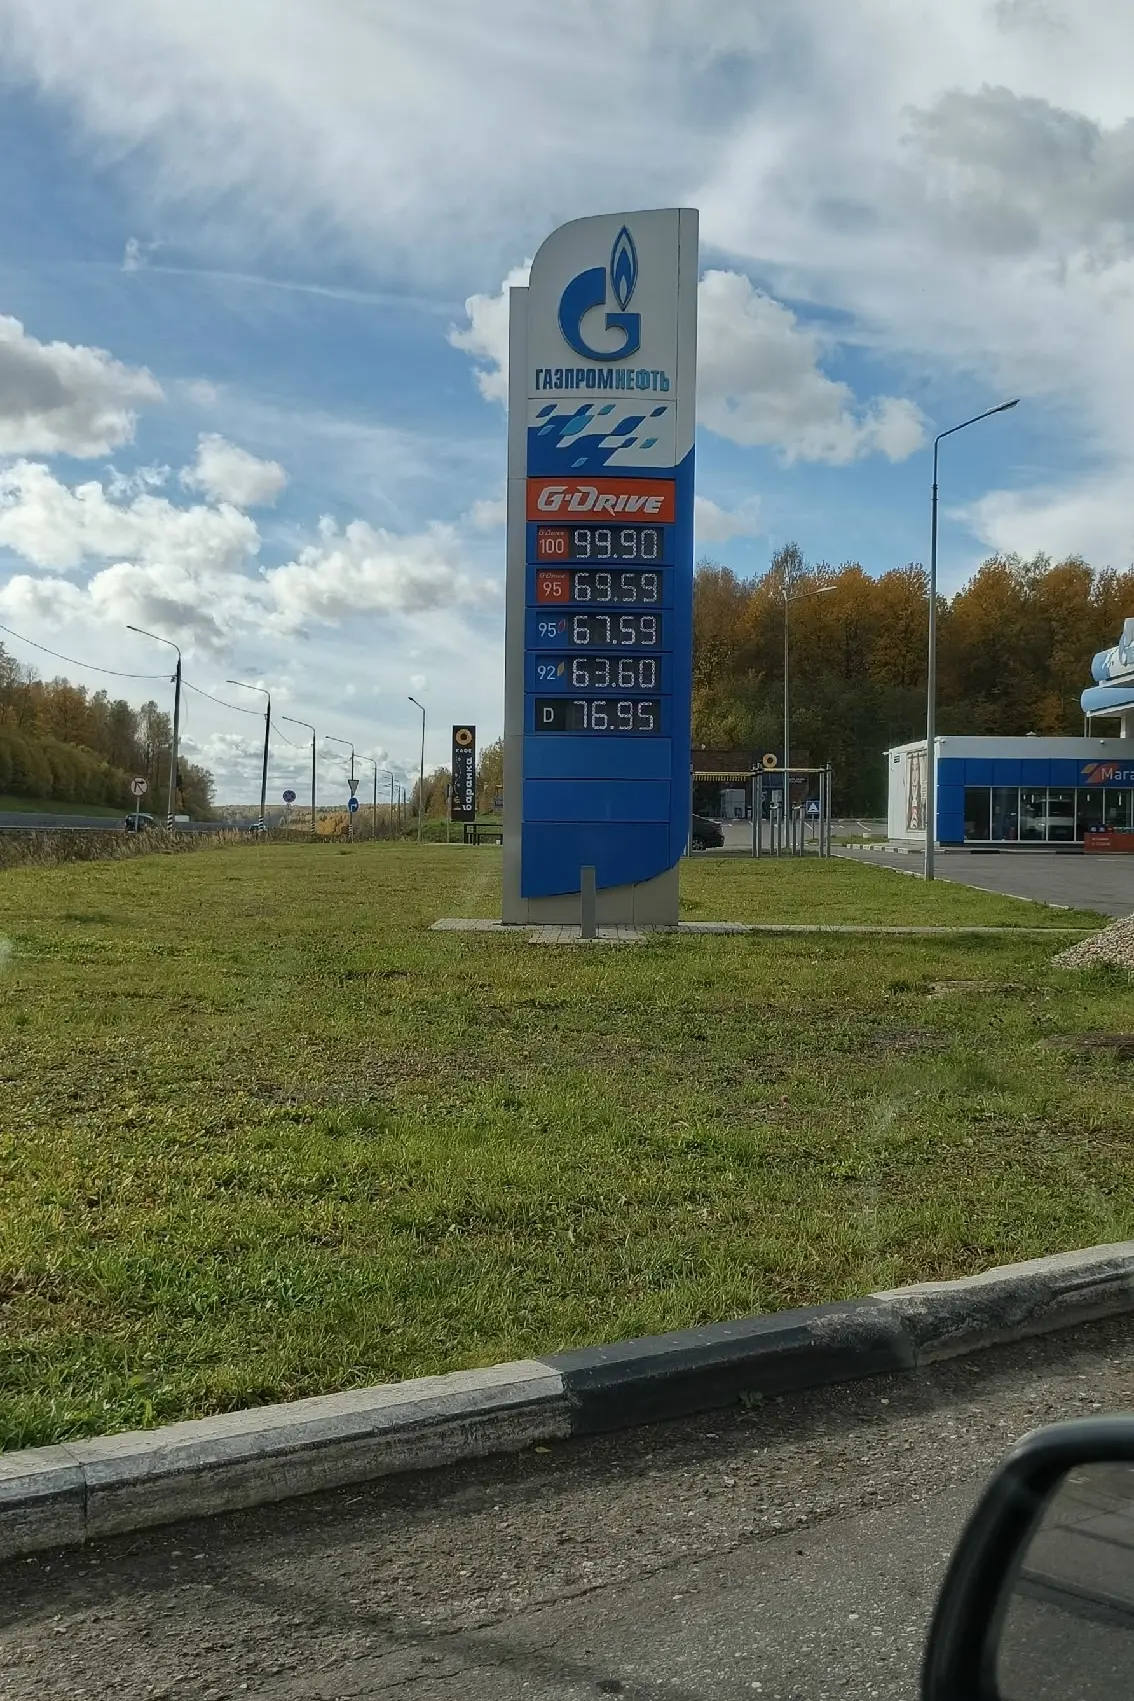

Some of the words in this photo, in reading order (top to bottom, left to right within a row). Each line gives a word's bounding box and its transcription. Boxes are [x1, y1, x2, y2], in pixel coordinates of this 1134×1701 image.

[535, 368, 670, 392] ГАЗПРОМНЕФТЬ
[539, 539, 564, 554] 100
[574, 529, 658, 559] 99.90
[543, 581, 562, 597] 95
[574, 572, 658, 603] 69.59
[538, 622, 557, 638] 95
[573, 615, 656, 645] 67.59
[537, 665, 556, 680] 92
[572, 658, 656, 688] 63.60
[543, 707, 555, 723] D
[573, 700, 654, 730] 76.95
